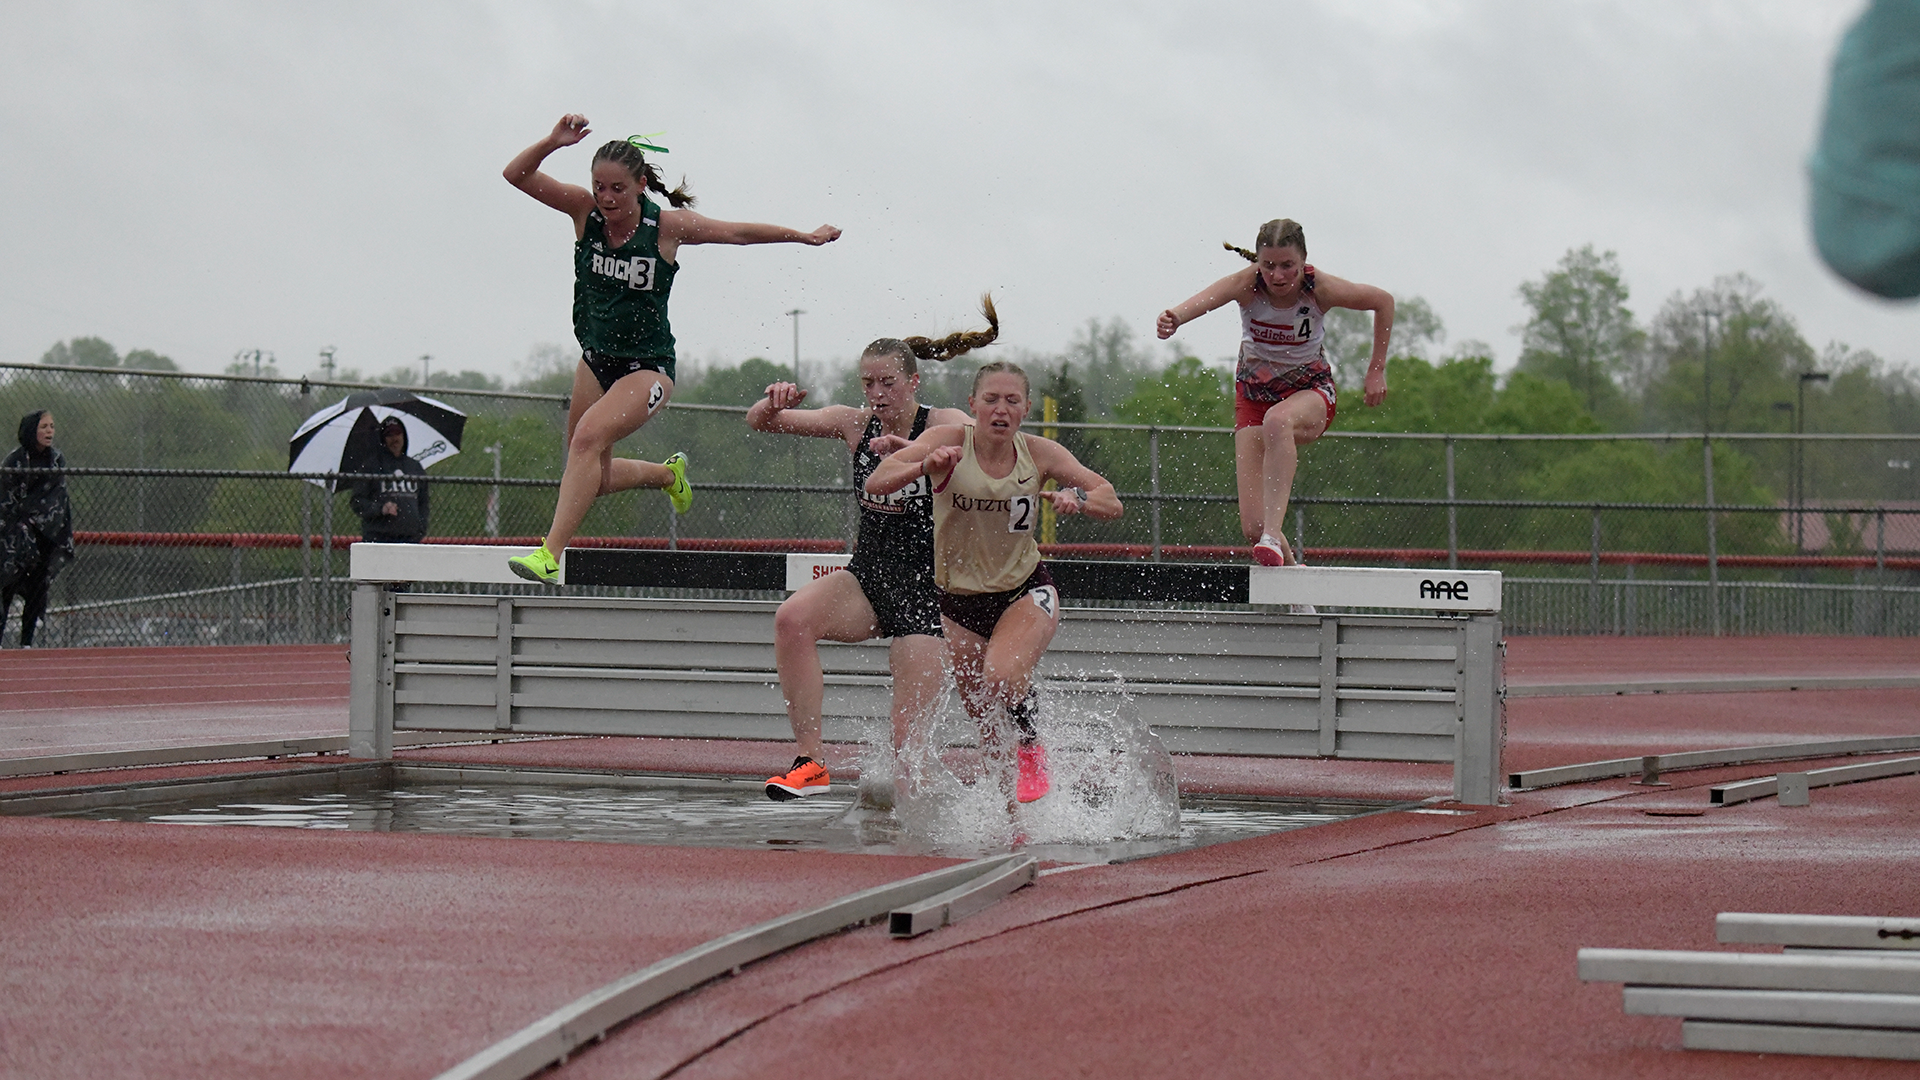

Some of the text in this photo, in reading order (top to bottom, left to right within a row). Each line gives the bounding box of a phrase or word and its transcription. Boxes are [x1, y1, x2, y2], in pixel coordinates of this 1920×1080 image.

[633, 259, 650, 289] 3
[1298, 318, 1312, 339] 4
[648, 386, 663, 409] 3
[952, 492, 1012, 512] KUTZTO
[1013, 497, 1031, 531] 2
[1034, 588, 1052, 615] 2
